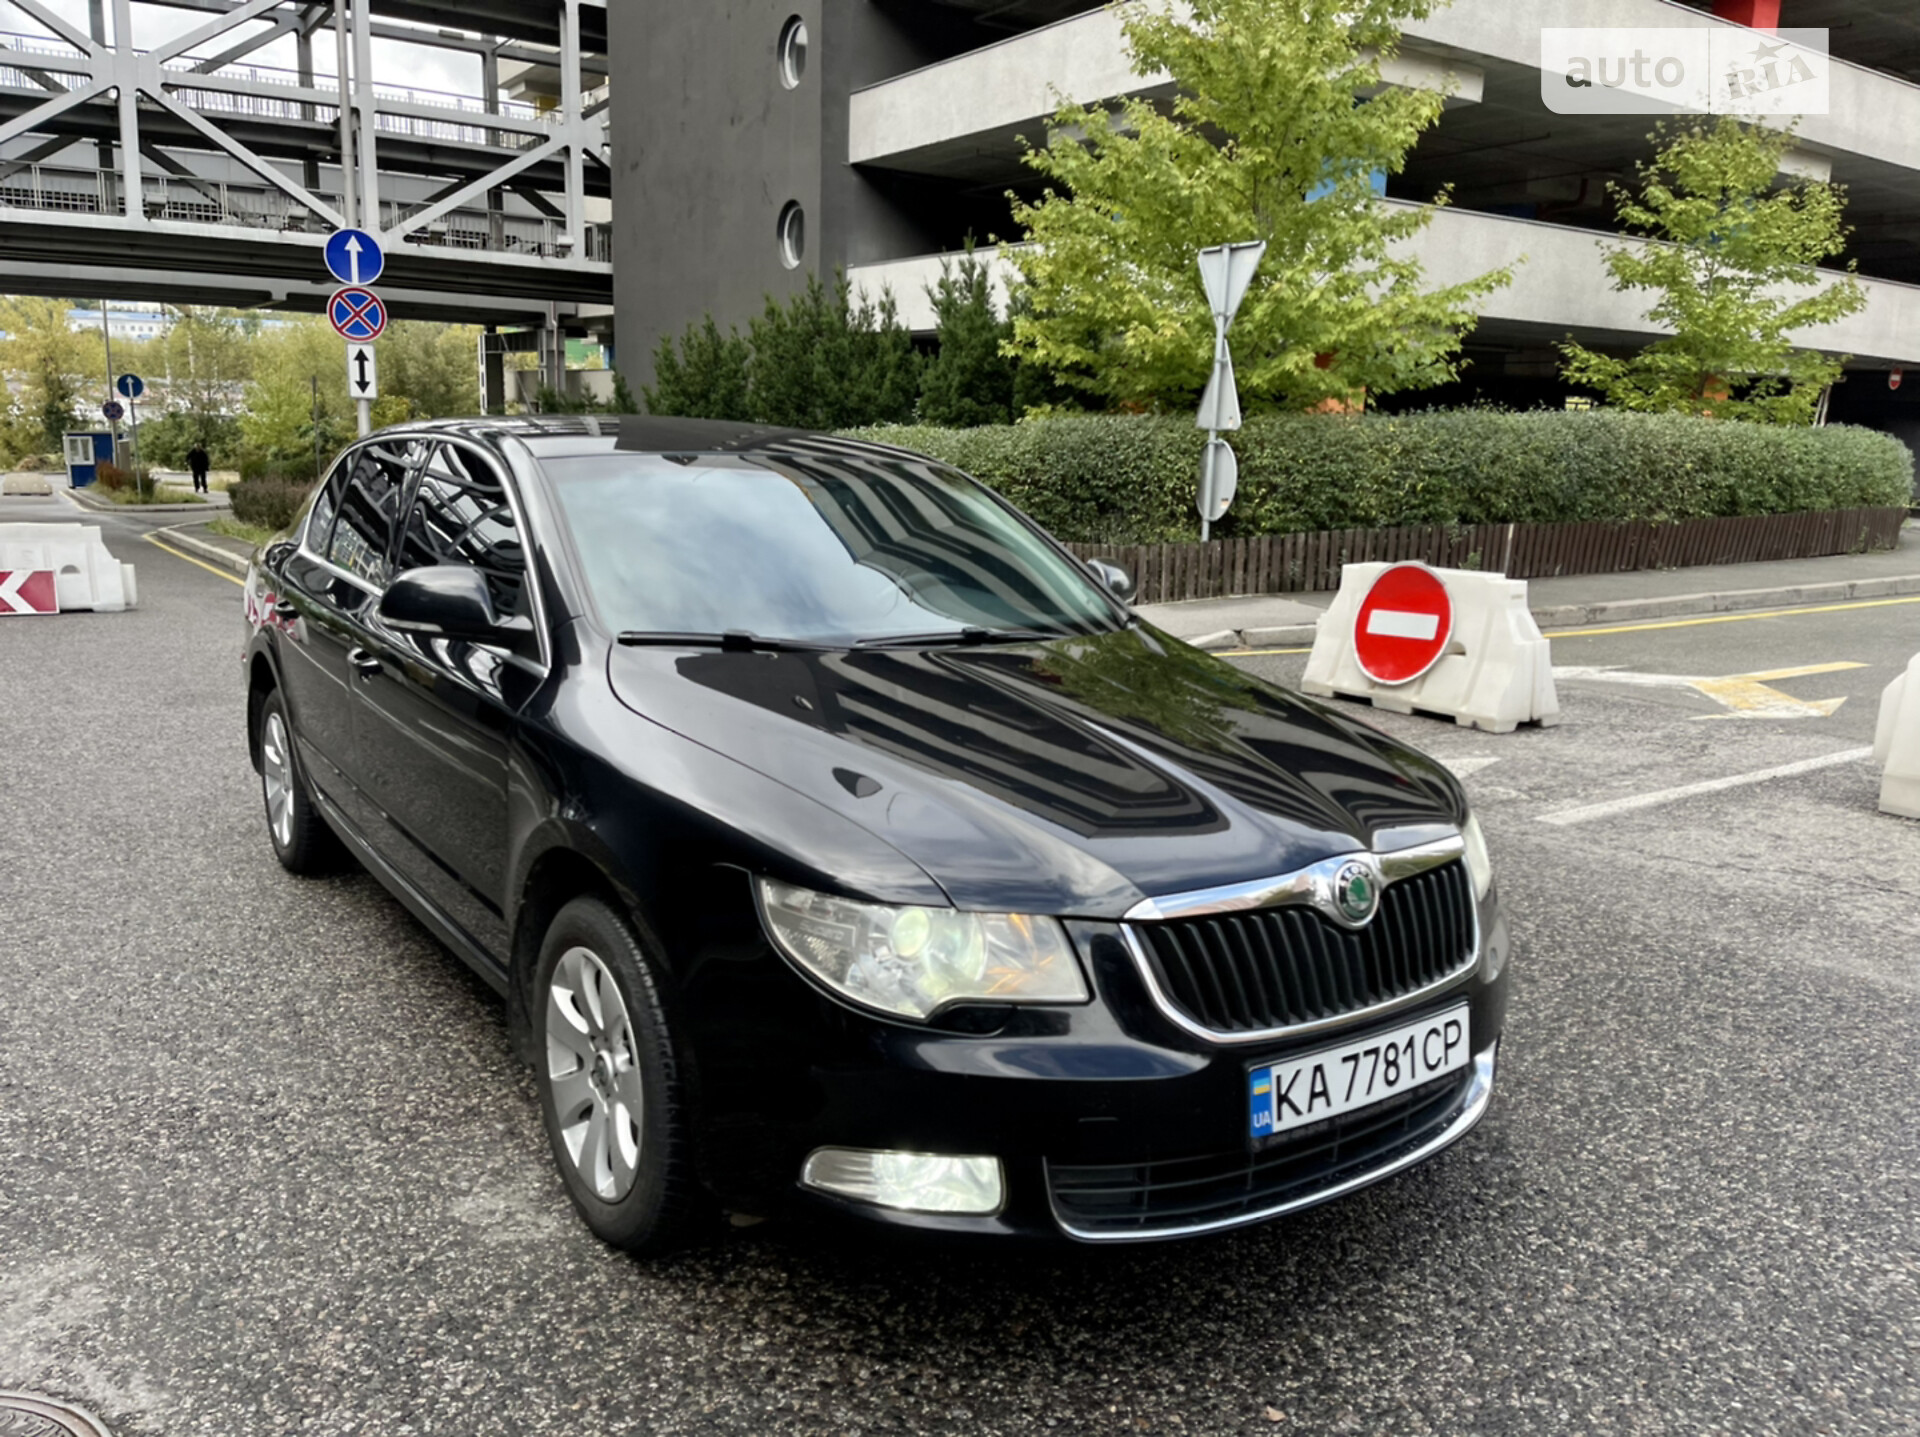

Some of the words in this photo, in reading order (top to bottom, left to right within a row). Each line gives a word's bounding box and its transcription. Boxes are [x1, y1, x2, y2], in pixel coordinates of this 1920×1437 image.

[1275, 1063, 1332, 1122] KA
[1341, 1034, 1416, 1103] 7781
[1423, 1018, 1462, 1072] CP
[1253, 1111, 1272, 1128] UA
